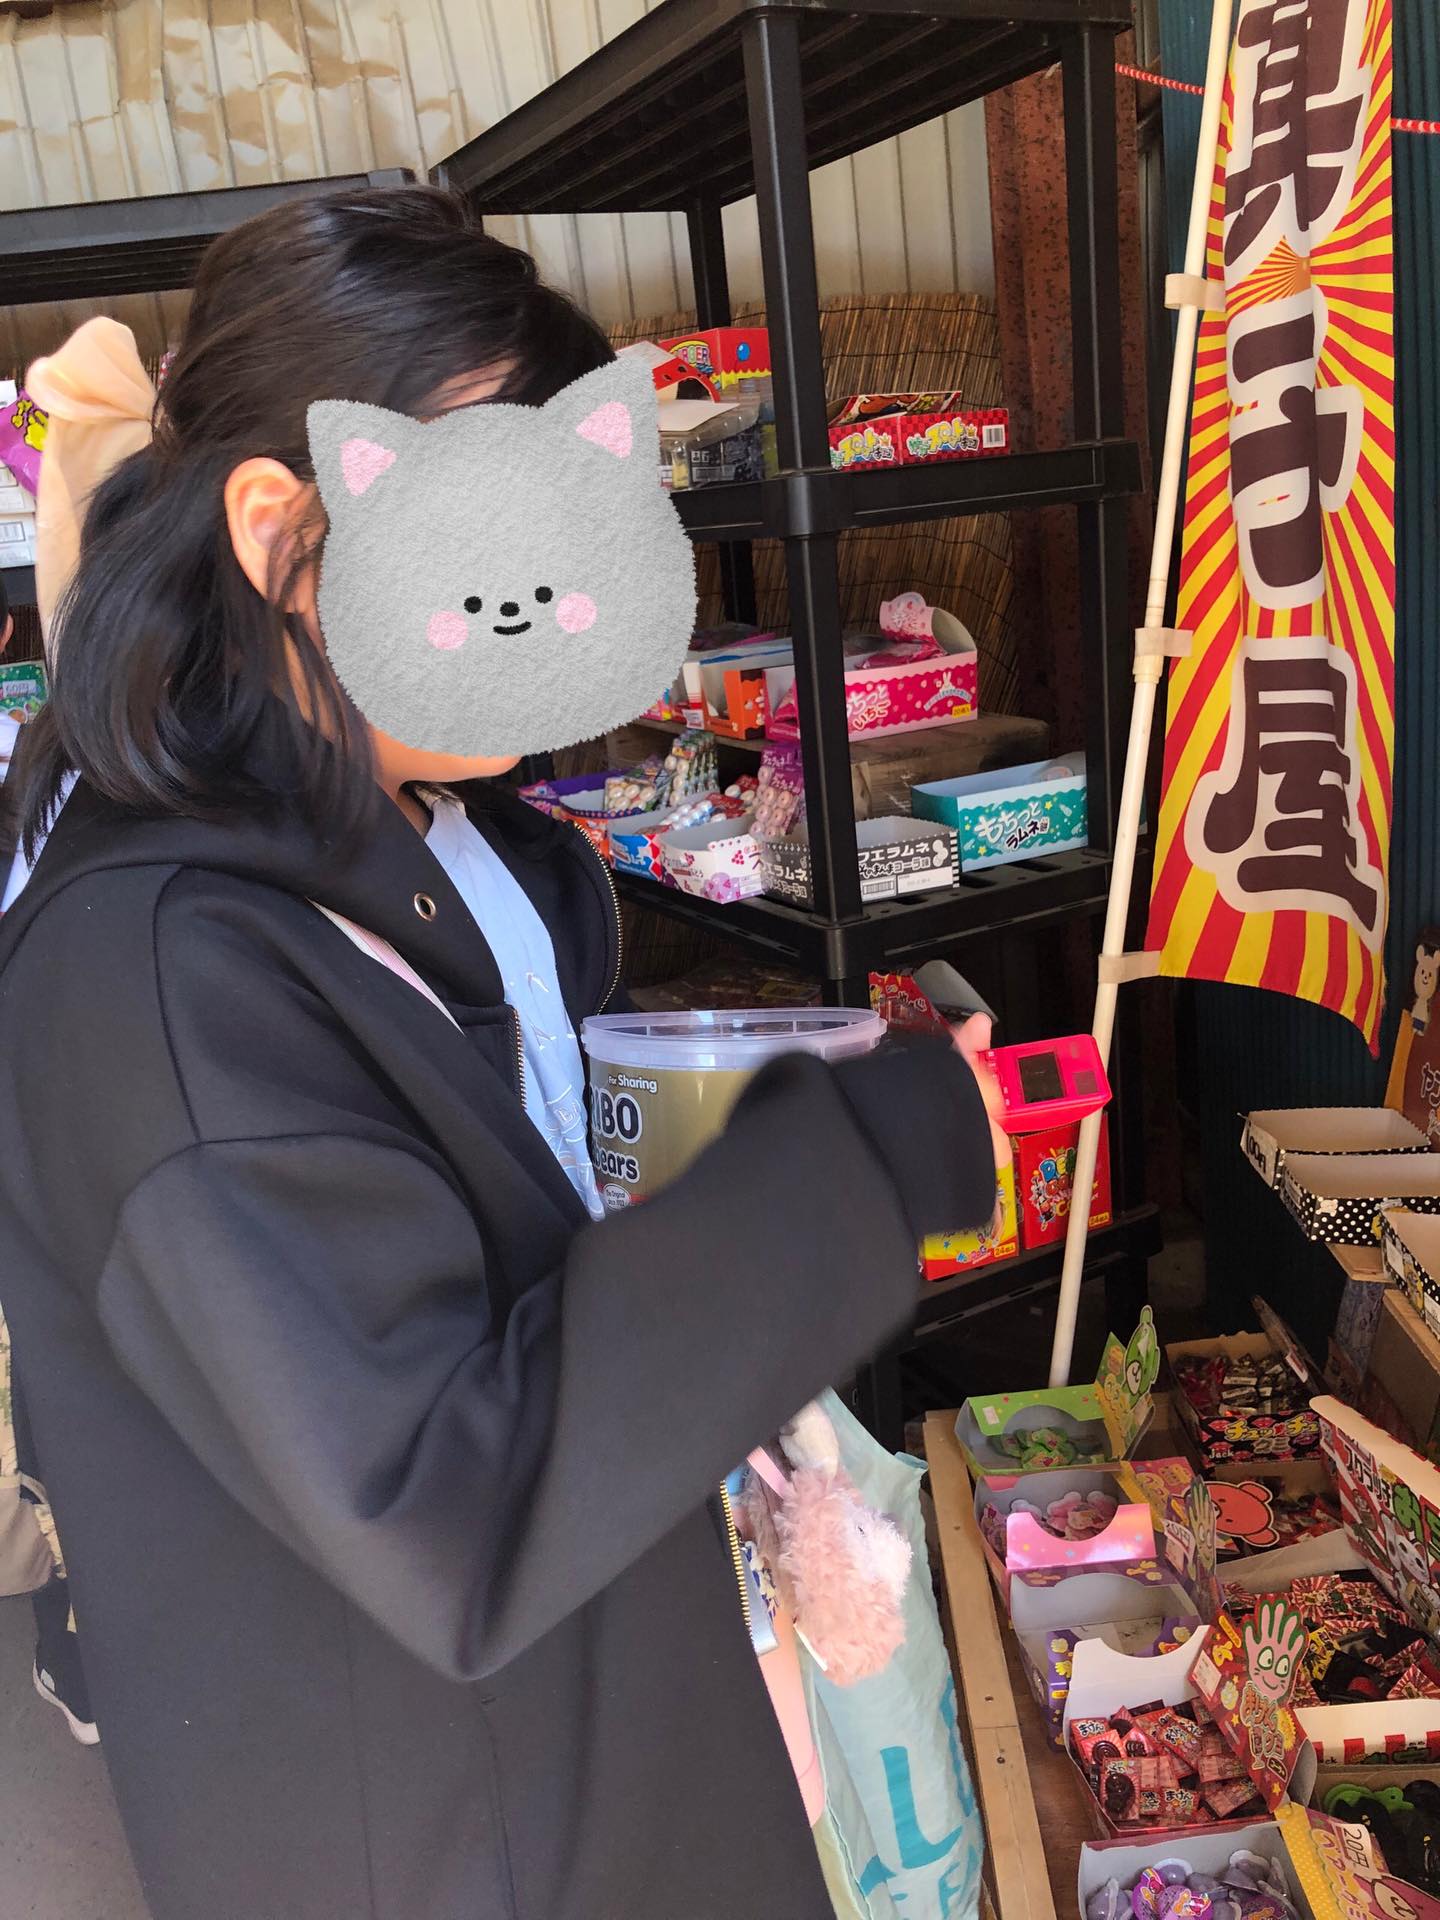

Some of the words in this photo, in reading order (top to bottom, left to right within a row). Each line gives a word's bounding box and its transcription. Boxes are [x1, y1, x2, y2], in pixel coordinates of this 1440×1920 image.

[974, 802, 1041, 845] もちっと
[858, 842, 930, 863] フエラムネ
[618, 1074, 658, 1094] Sharing
[1208, 1448, 1234, 1459] Jack
[1078, 1722, 1105, 1738] まけん
[1164, 1789, 1193, 1802] まけん
[1342, 1827, 1370, 1869] 20円
